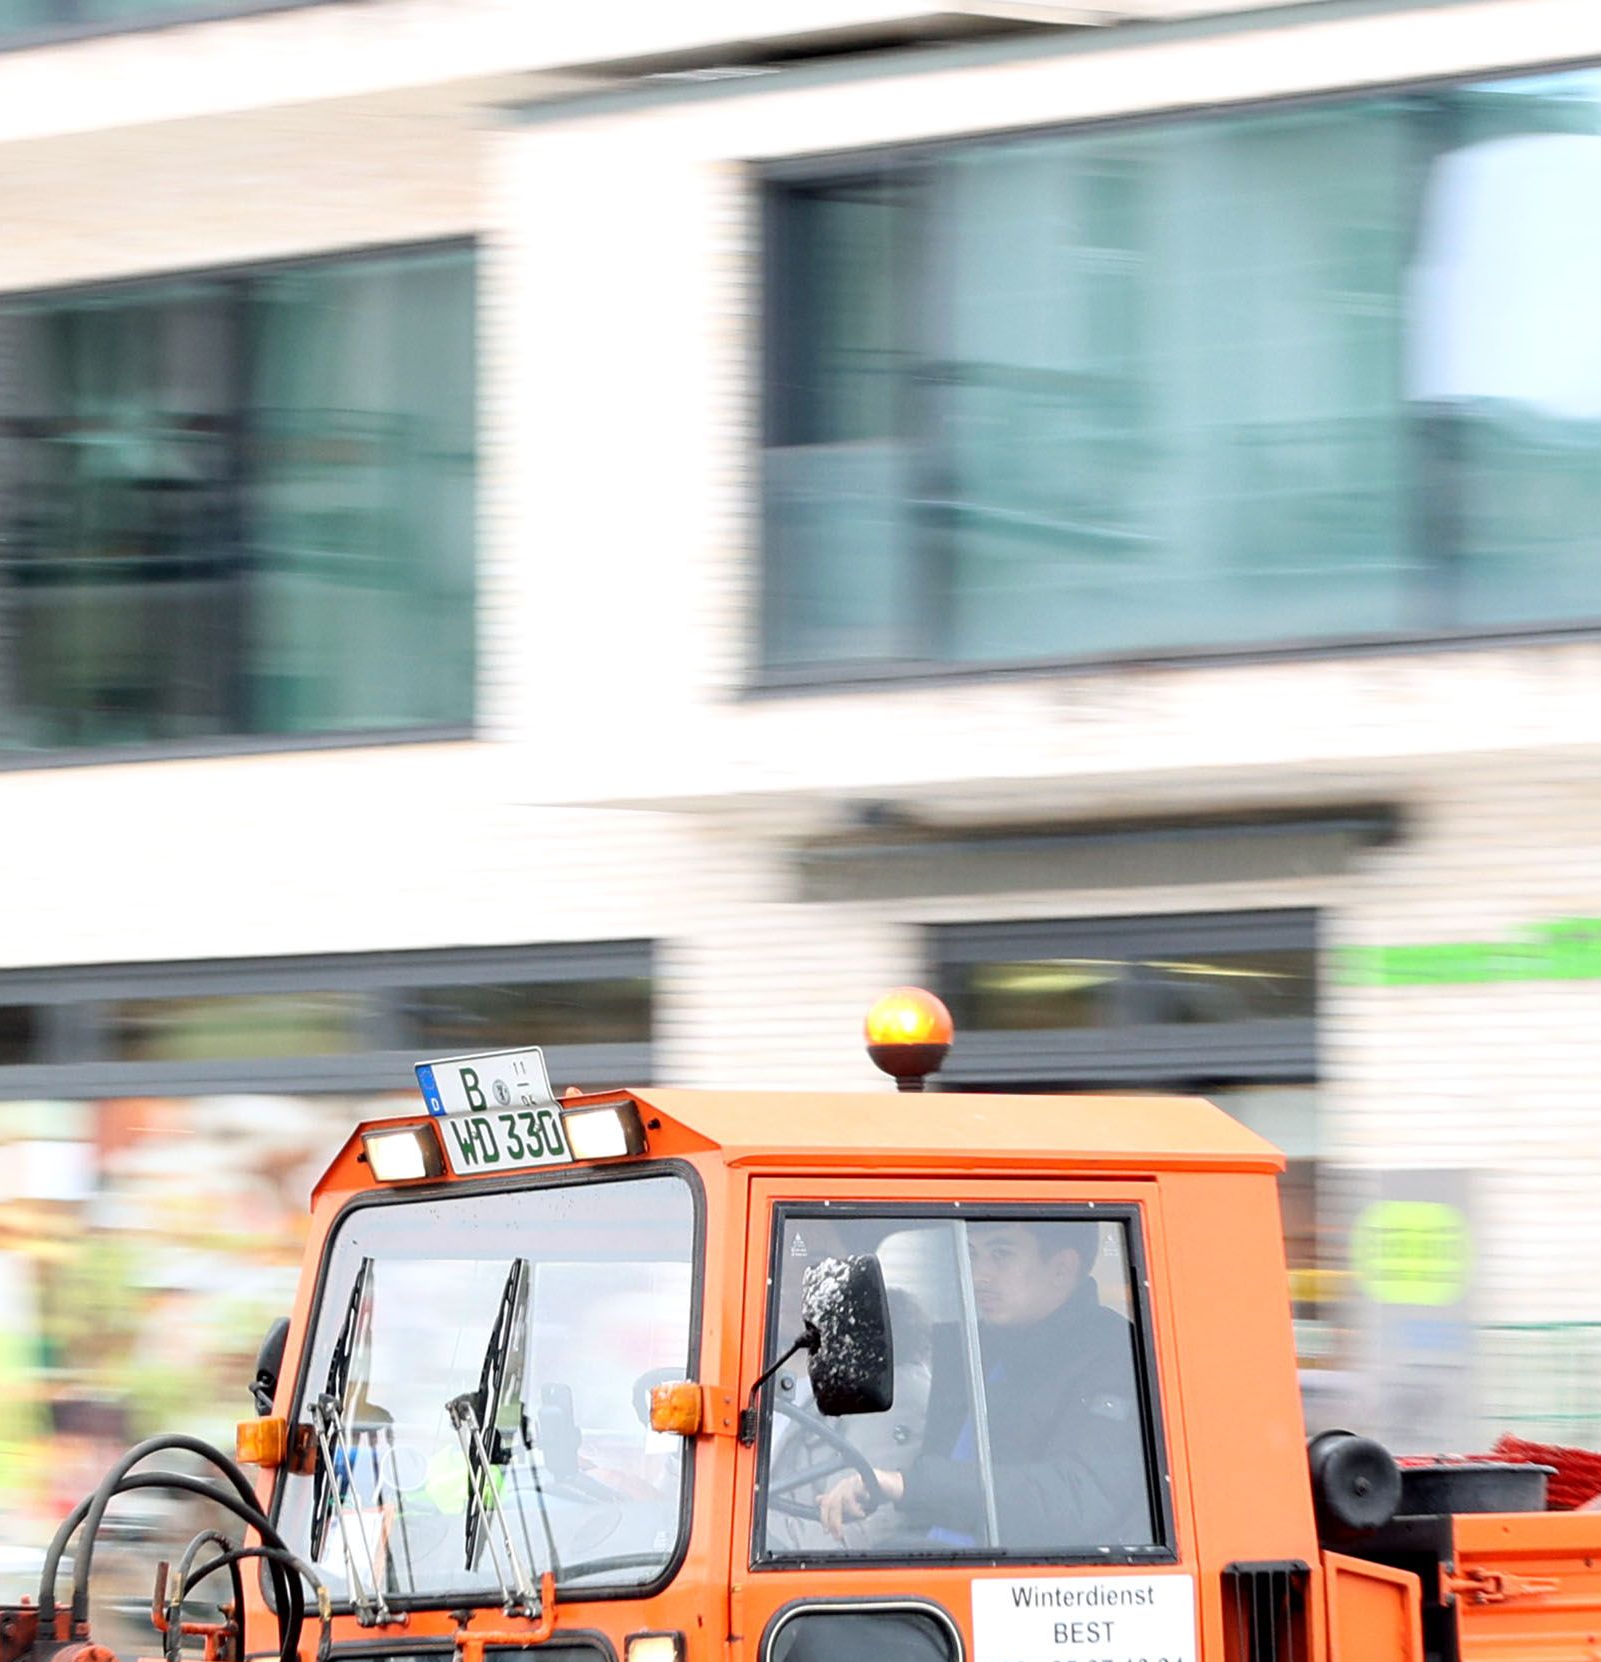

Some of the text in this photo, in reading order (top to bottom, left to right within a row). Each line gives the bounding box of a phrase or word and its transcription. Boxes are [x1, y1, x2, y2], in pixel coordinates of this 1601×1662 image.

[459, 1067, 487, 1112] B
[430, 1098, 441, 1111] D
[450, 1110, 565, 1165] WD 330
[1011, 1584, 1155, 1608] Winterdienst
[1053, 1621, 1115, 1644] BEST
